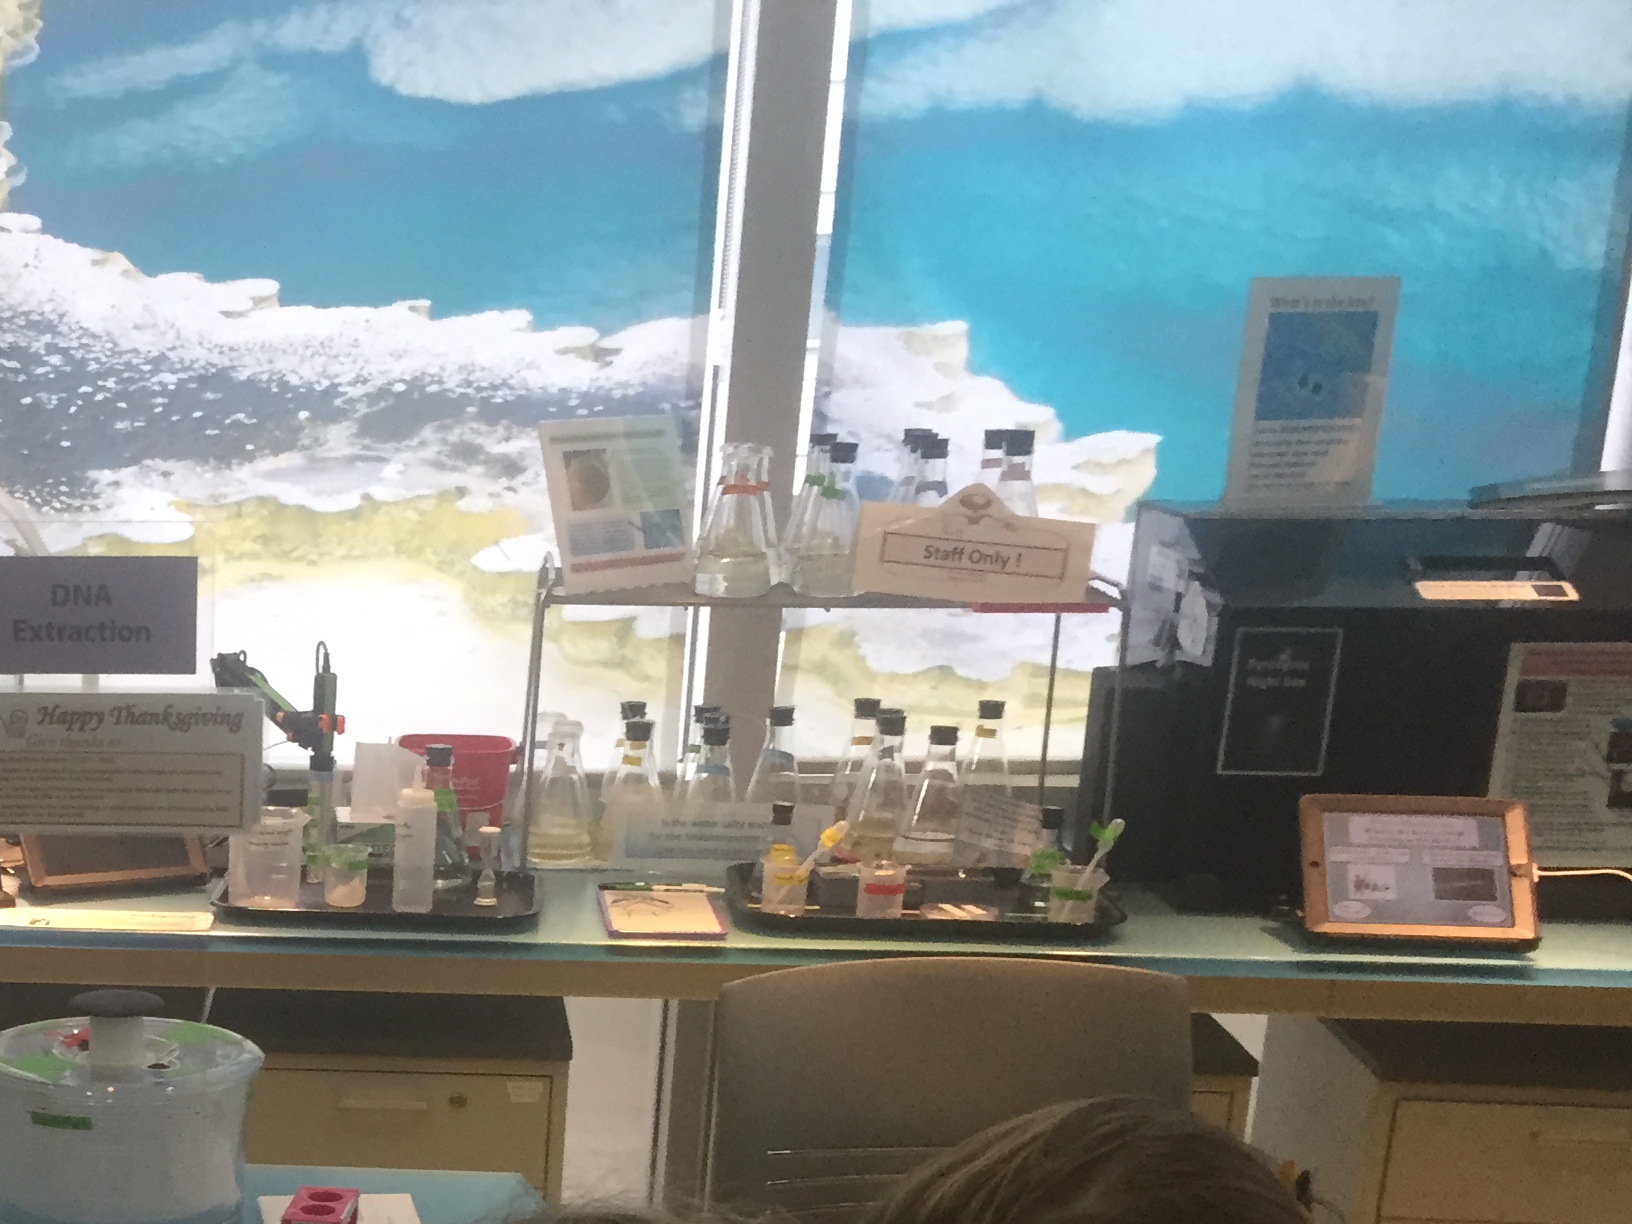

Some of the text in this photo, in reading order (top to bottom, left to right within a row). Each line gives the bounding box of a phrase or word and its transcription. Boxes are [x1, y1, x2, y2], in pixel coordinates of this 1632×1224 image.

[923, 544, 1023, 570] Staff Only !
[50, 583, 113, 607] DNA
[12, 619, 152, 643] Extraction
[36, 703, 245, 734] Happy Thanksgiving
